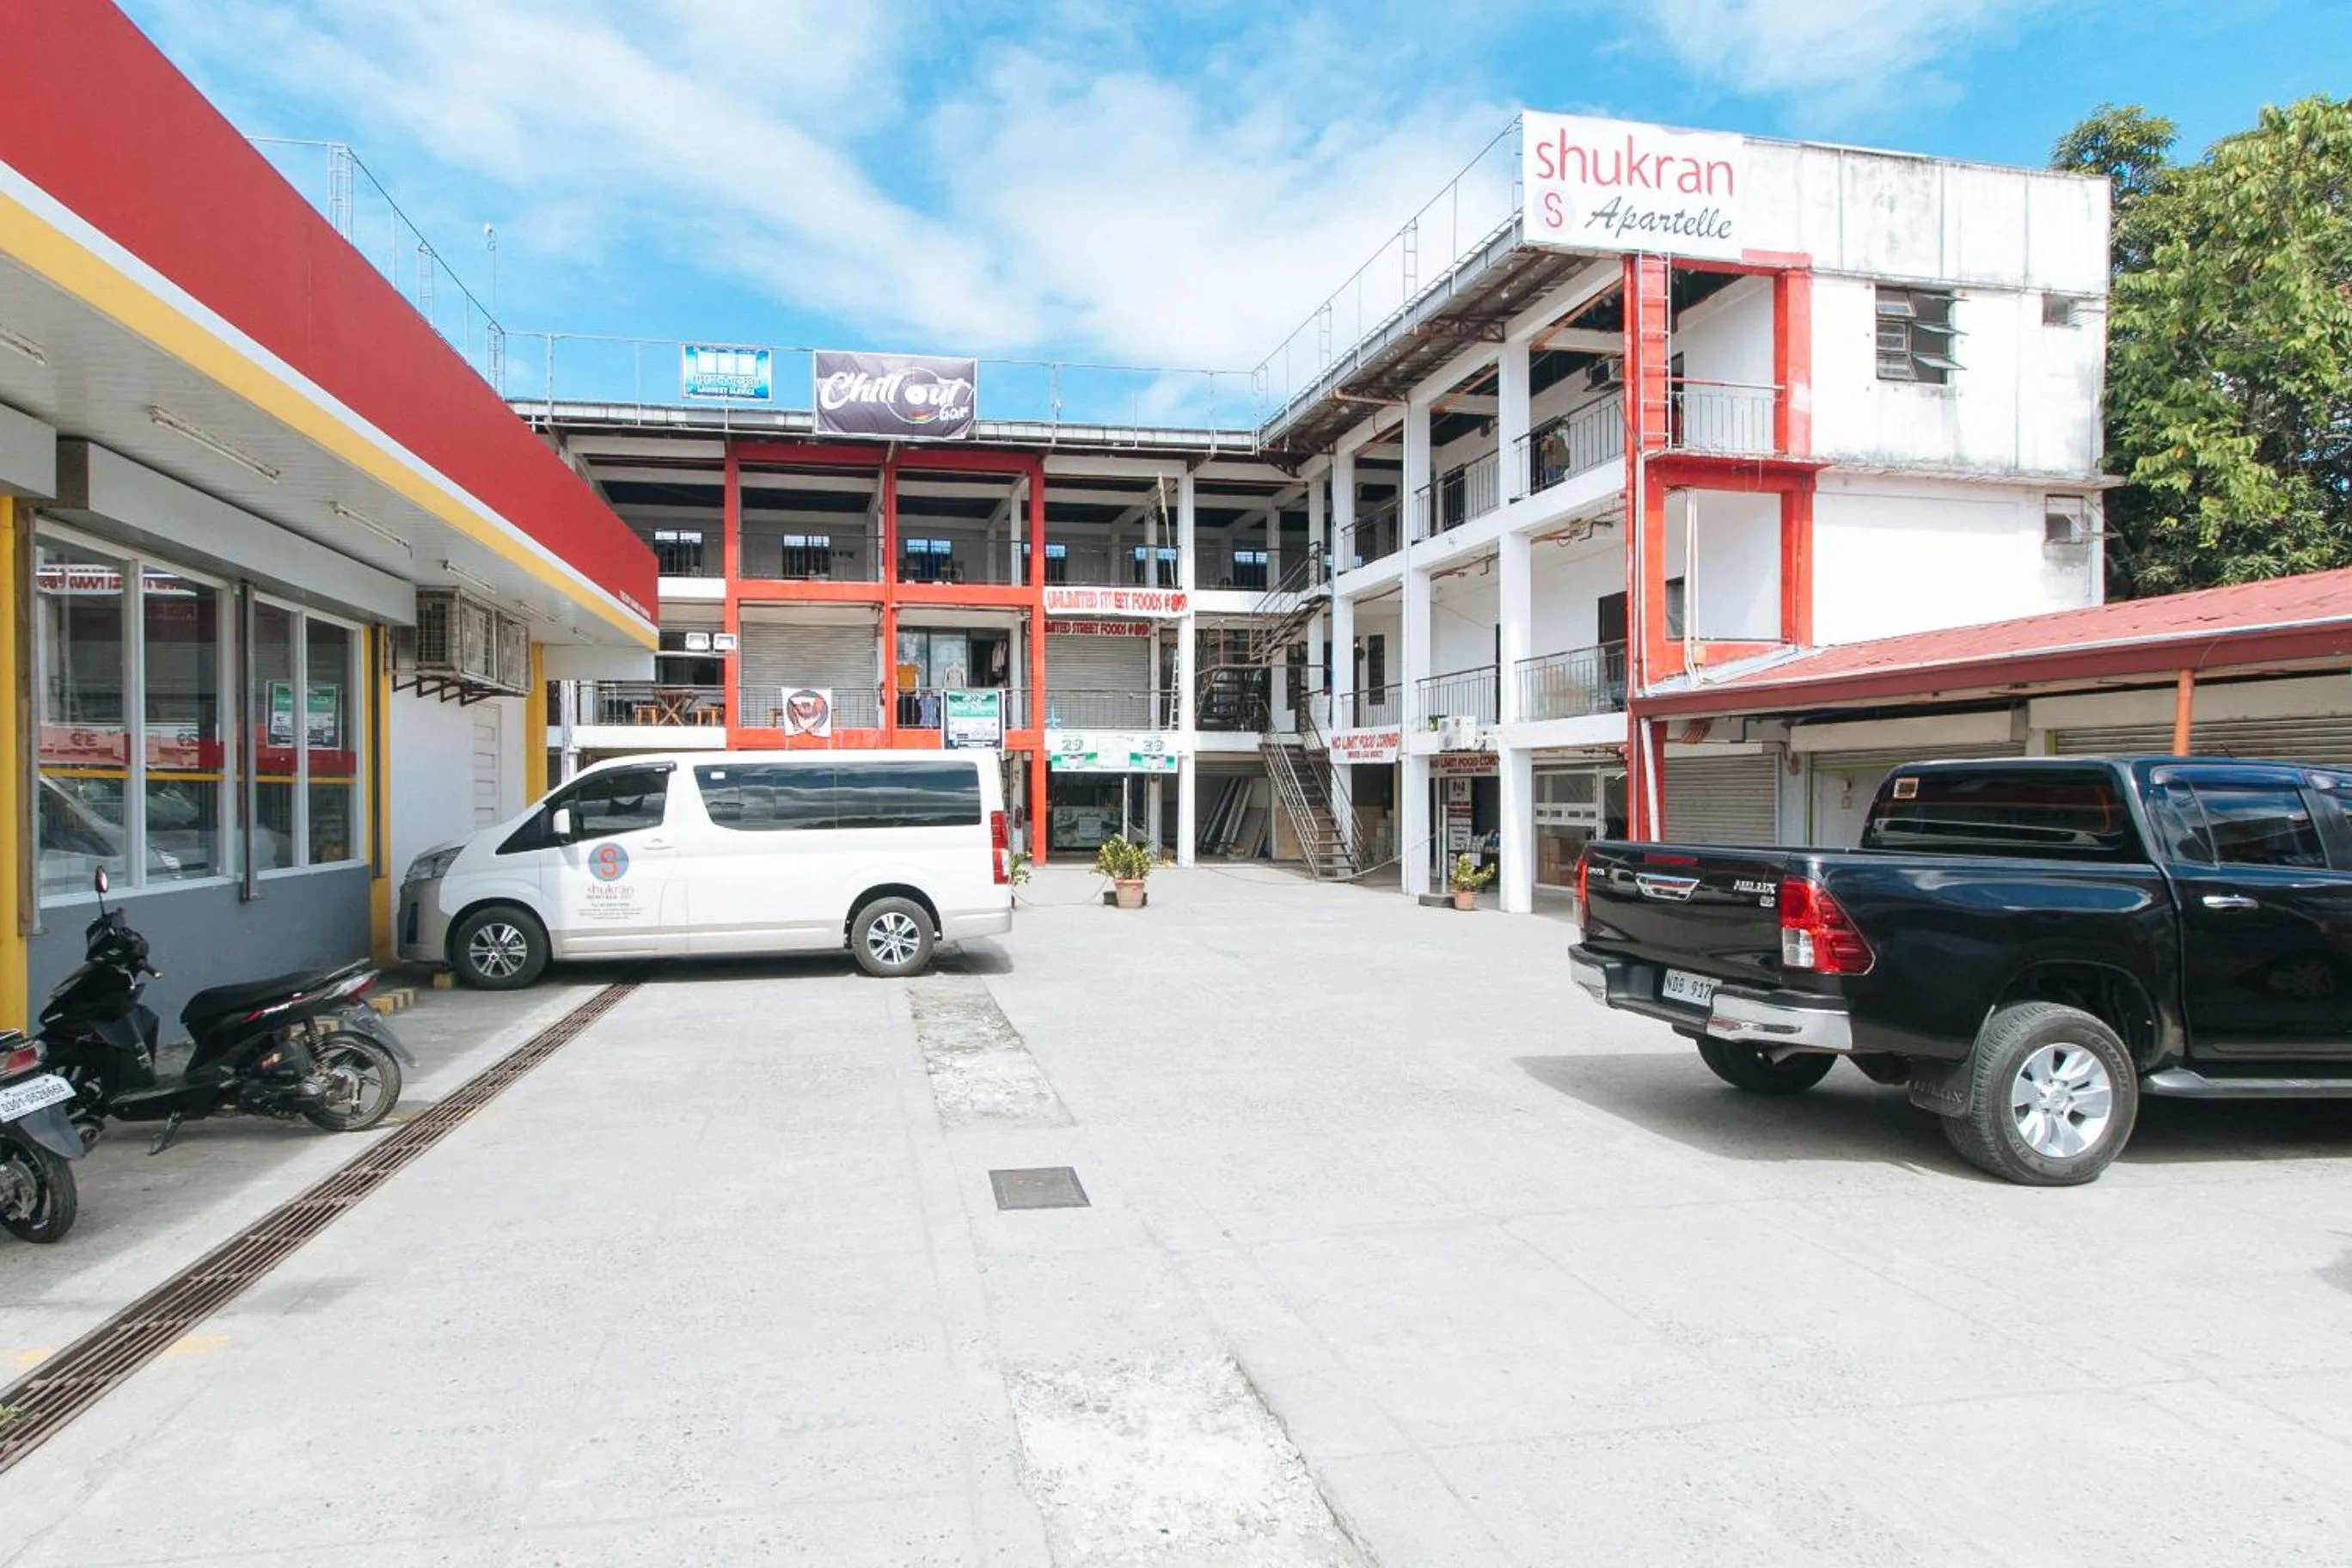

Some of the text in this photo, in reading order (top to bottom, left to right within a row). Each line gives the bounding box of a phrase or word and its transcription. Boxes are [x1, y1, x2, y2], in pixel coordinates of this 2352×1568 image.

[1536, 127, 1734, 197] shukran
[1544, 192, 1564, 228] S
[1584, 195, 1733, 240] Apartelle
[599, 848, 617, 877] S
[1690, 980, 1713, 1000] 917
